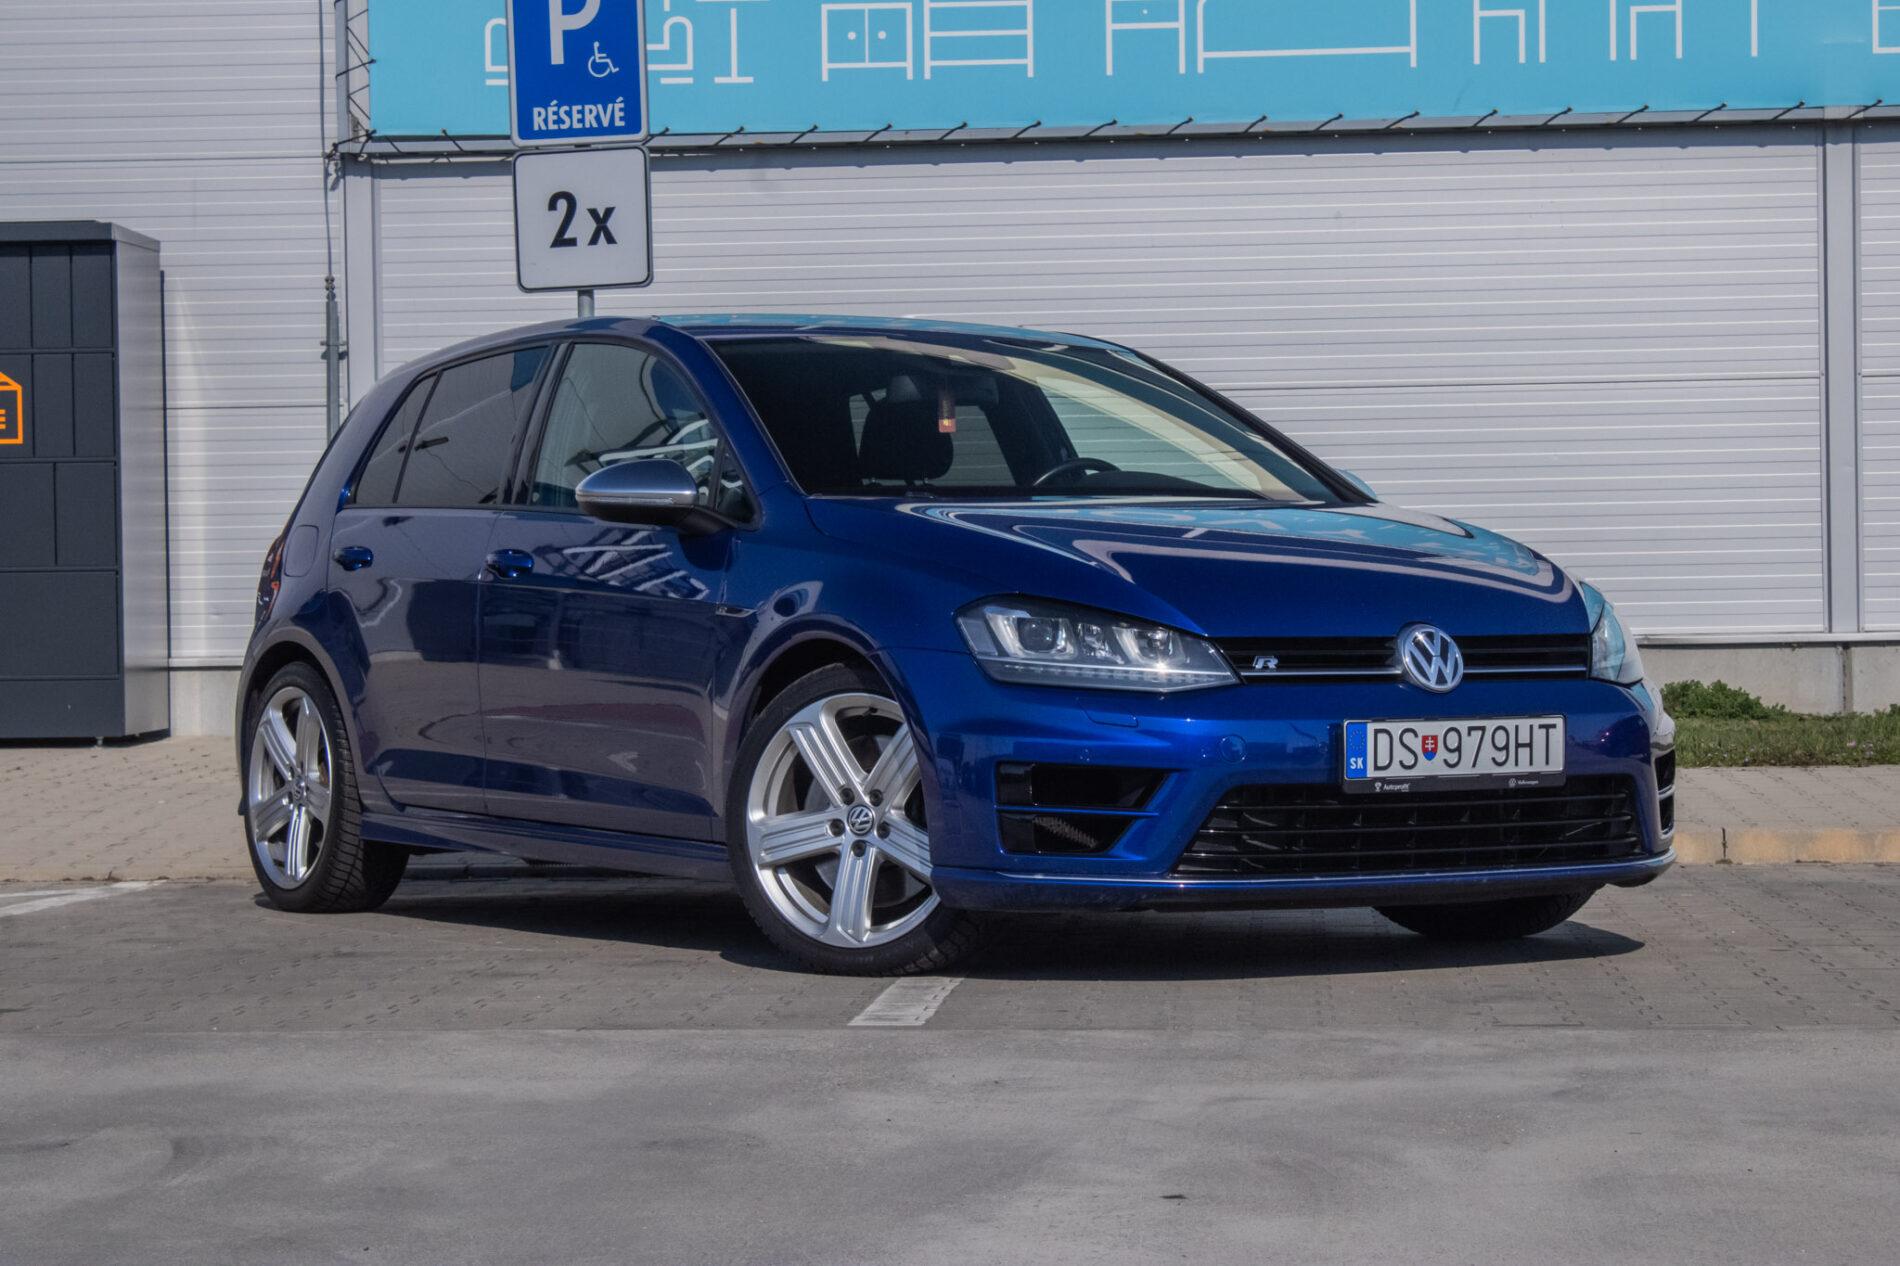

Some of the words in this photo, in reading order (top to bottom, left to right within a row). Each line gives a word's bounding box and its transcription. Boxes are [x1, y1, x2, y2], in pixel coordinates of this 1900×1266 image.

[549, 0, 601, 64] P
[533, 96, 626, 132] RÉSERVÉ
[547, 190, 618, 248] 2x
[1253, 655, 1279, 669] R
[1350, 757, 1364, 770] SK
